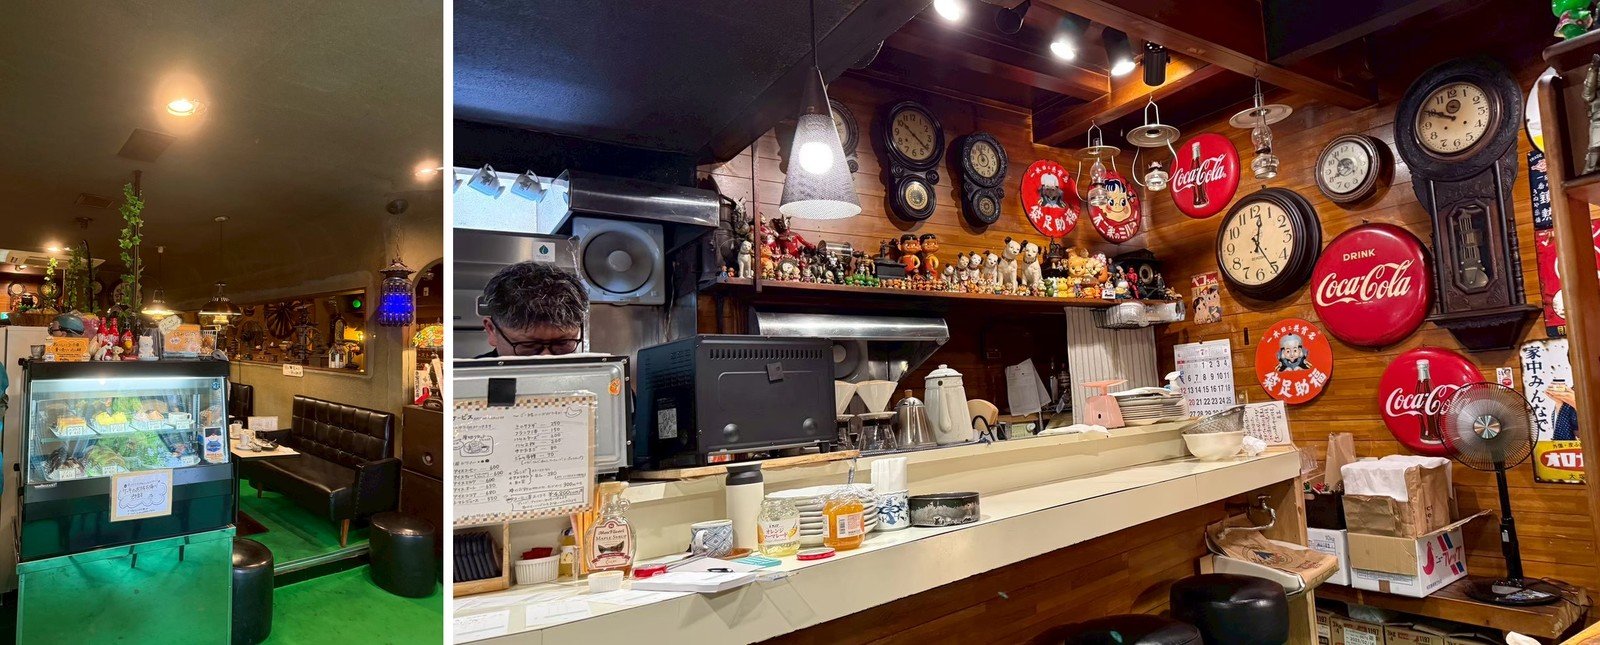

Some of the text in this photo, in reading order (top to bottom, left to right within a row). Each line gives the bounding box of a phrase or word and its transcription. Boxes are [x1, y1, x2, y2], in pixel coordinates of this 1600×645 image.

[1447, 89, 1457, 98] 12
[1472, 96, 1480, 105] 2
[1453, 138, 1461, 146] 6
[1466, 132, 1473, 141] 5
[1250, 205, 1260, 219] 12
[1267, 206, 1272, 218] 1
[1239, 213, 1246, 226] 11
[1277, 214, 1286, 228] 2
[1229, 227, 1240, 240] 10
[1283, 230, 1292, 243] 3
[1226, 243, 1235, 256] 9
[1279, 247, 1289, 260] 4
[1343, 249, 1375, 261] DRINK
[1232, 257, 1241, 270] 8
[1243, 266, 1250, 280] 7
[1256, 268, 1265, 281] 6
[1316, 258, 1415, 307] Coca-Cola
[1525, 345, 1548, 432] 家中みんなで
